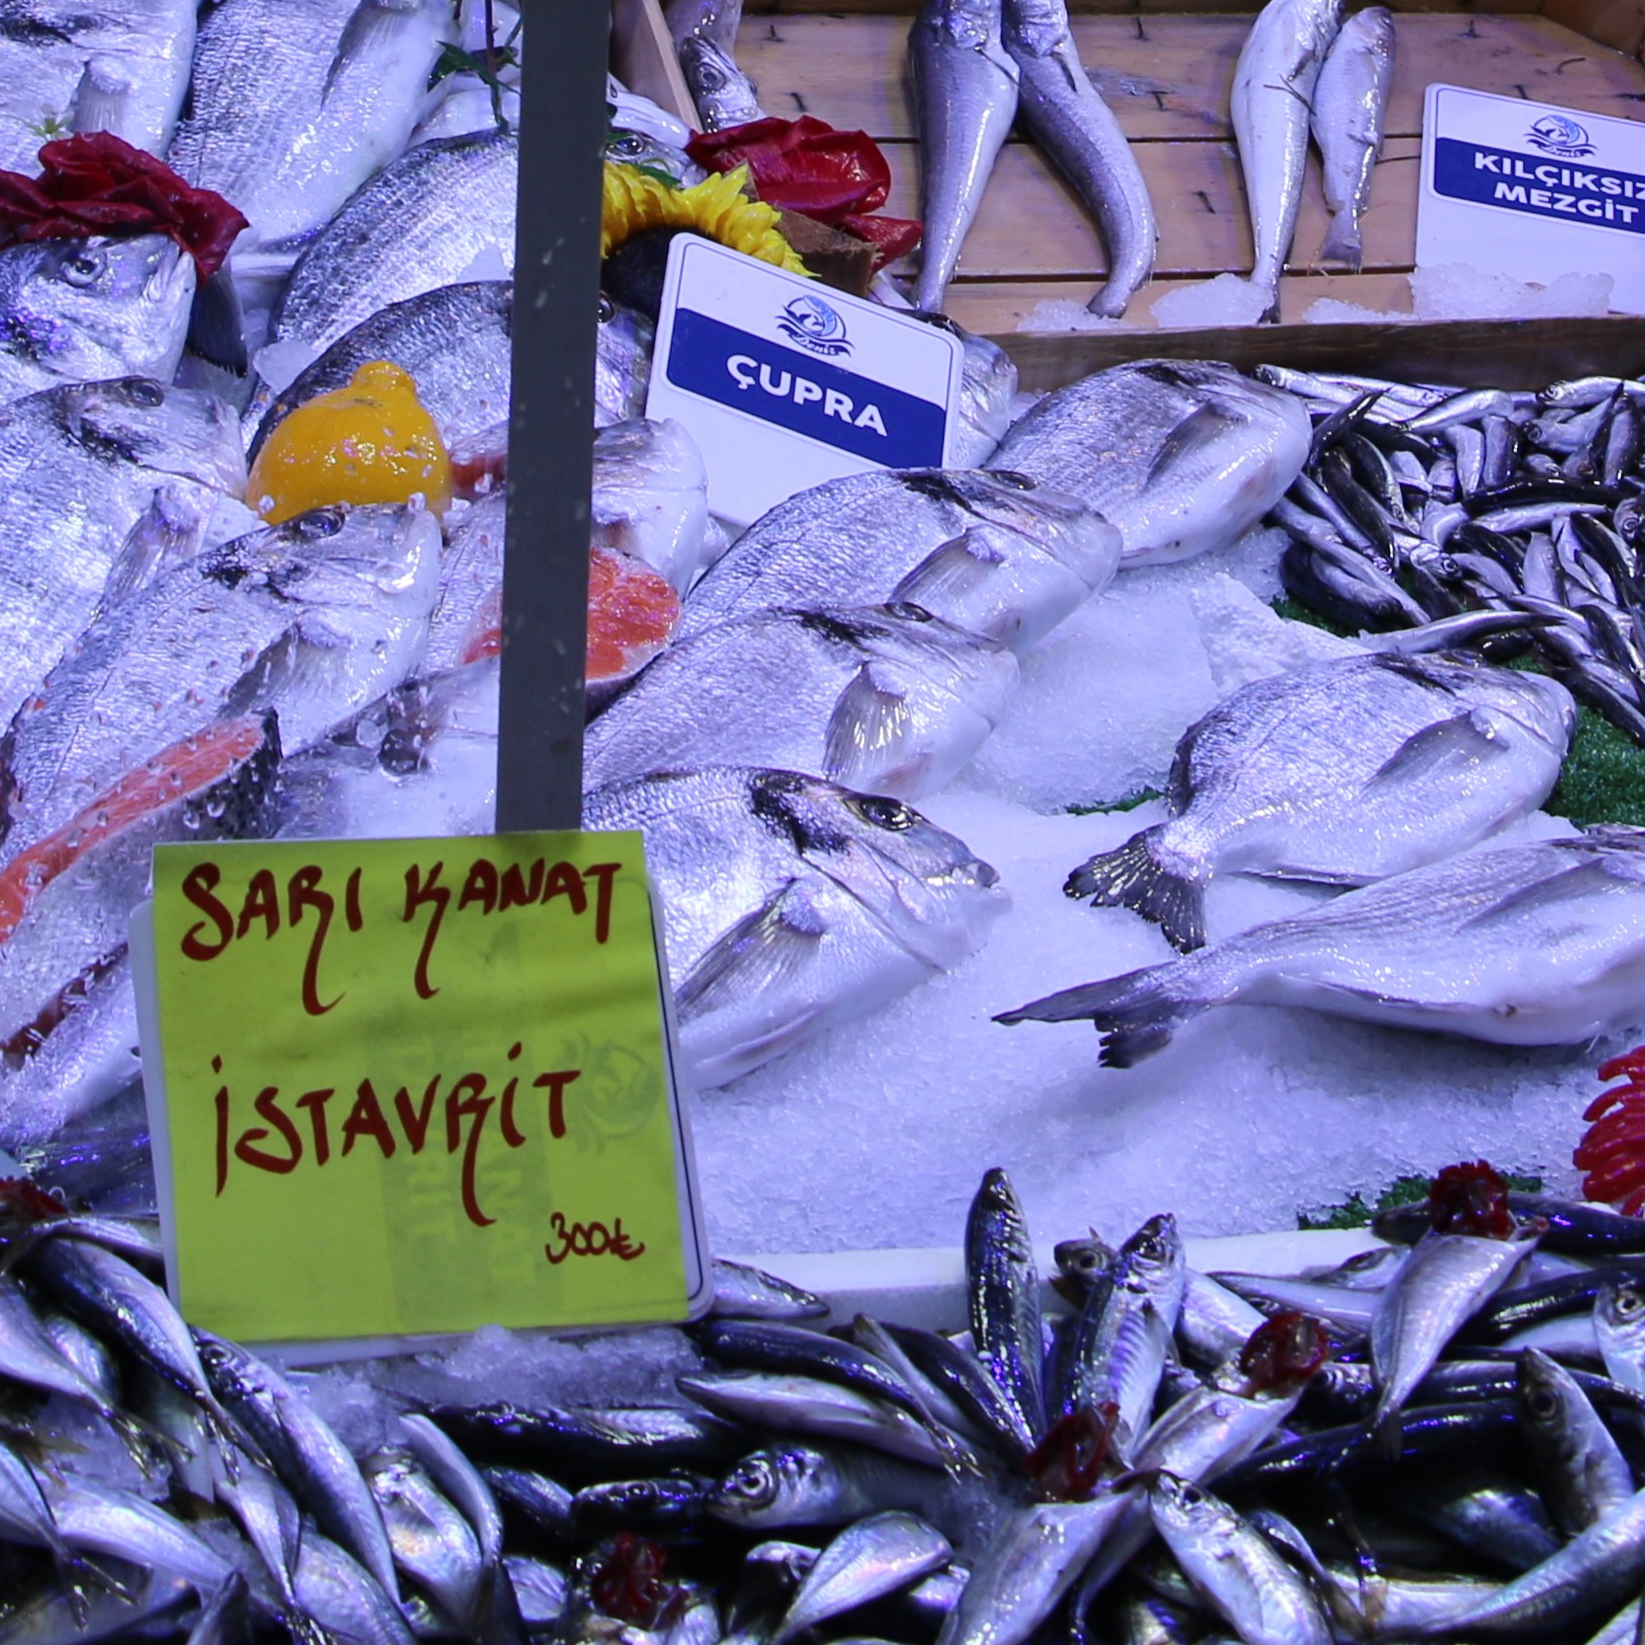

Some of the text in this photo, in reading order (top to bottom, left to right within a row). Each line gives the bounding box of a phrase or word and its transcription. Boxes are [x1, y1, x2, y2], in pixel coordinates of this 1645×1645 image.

[1494, 182, 1639, 223] MEZGİT
[726, 354, 889, 437] ÇUPRA
[180, 857, 622, 1016] SARI KANAT
[213, 1041, 582, 1227] İSTAVRİT
